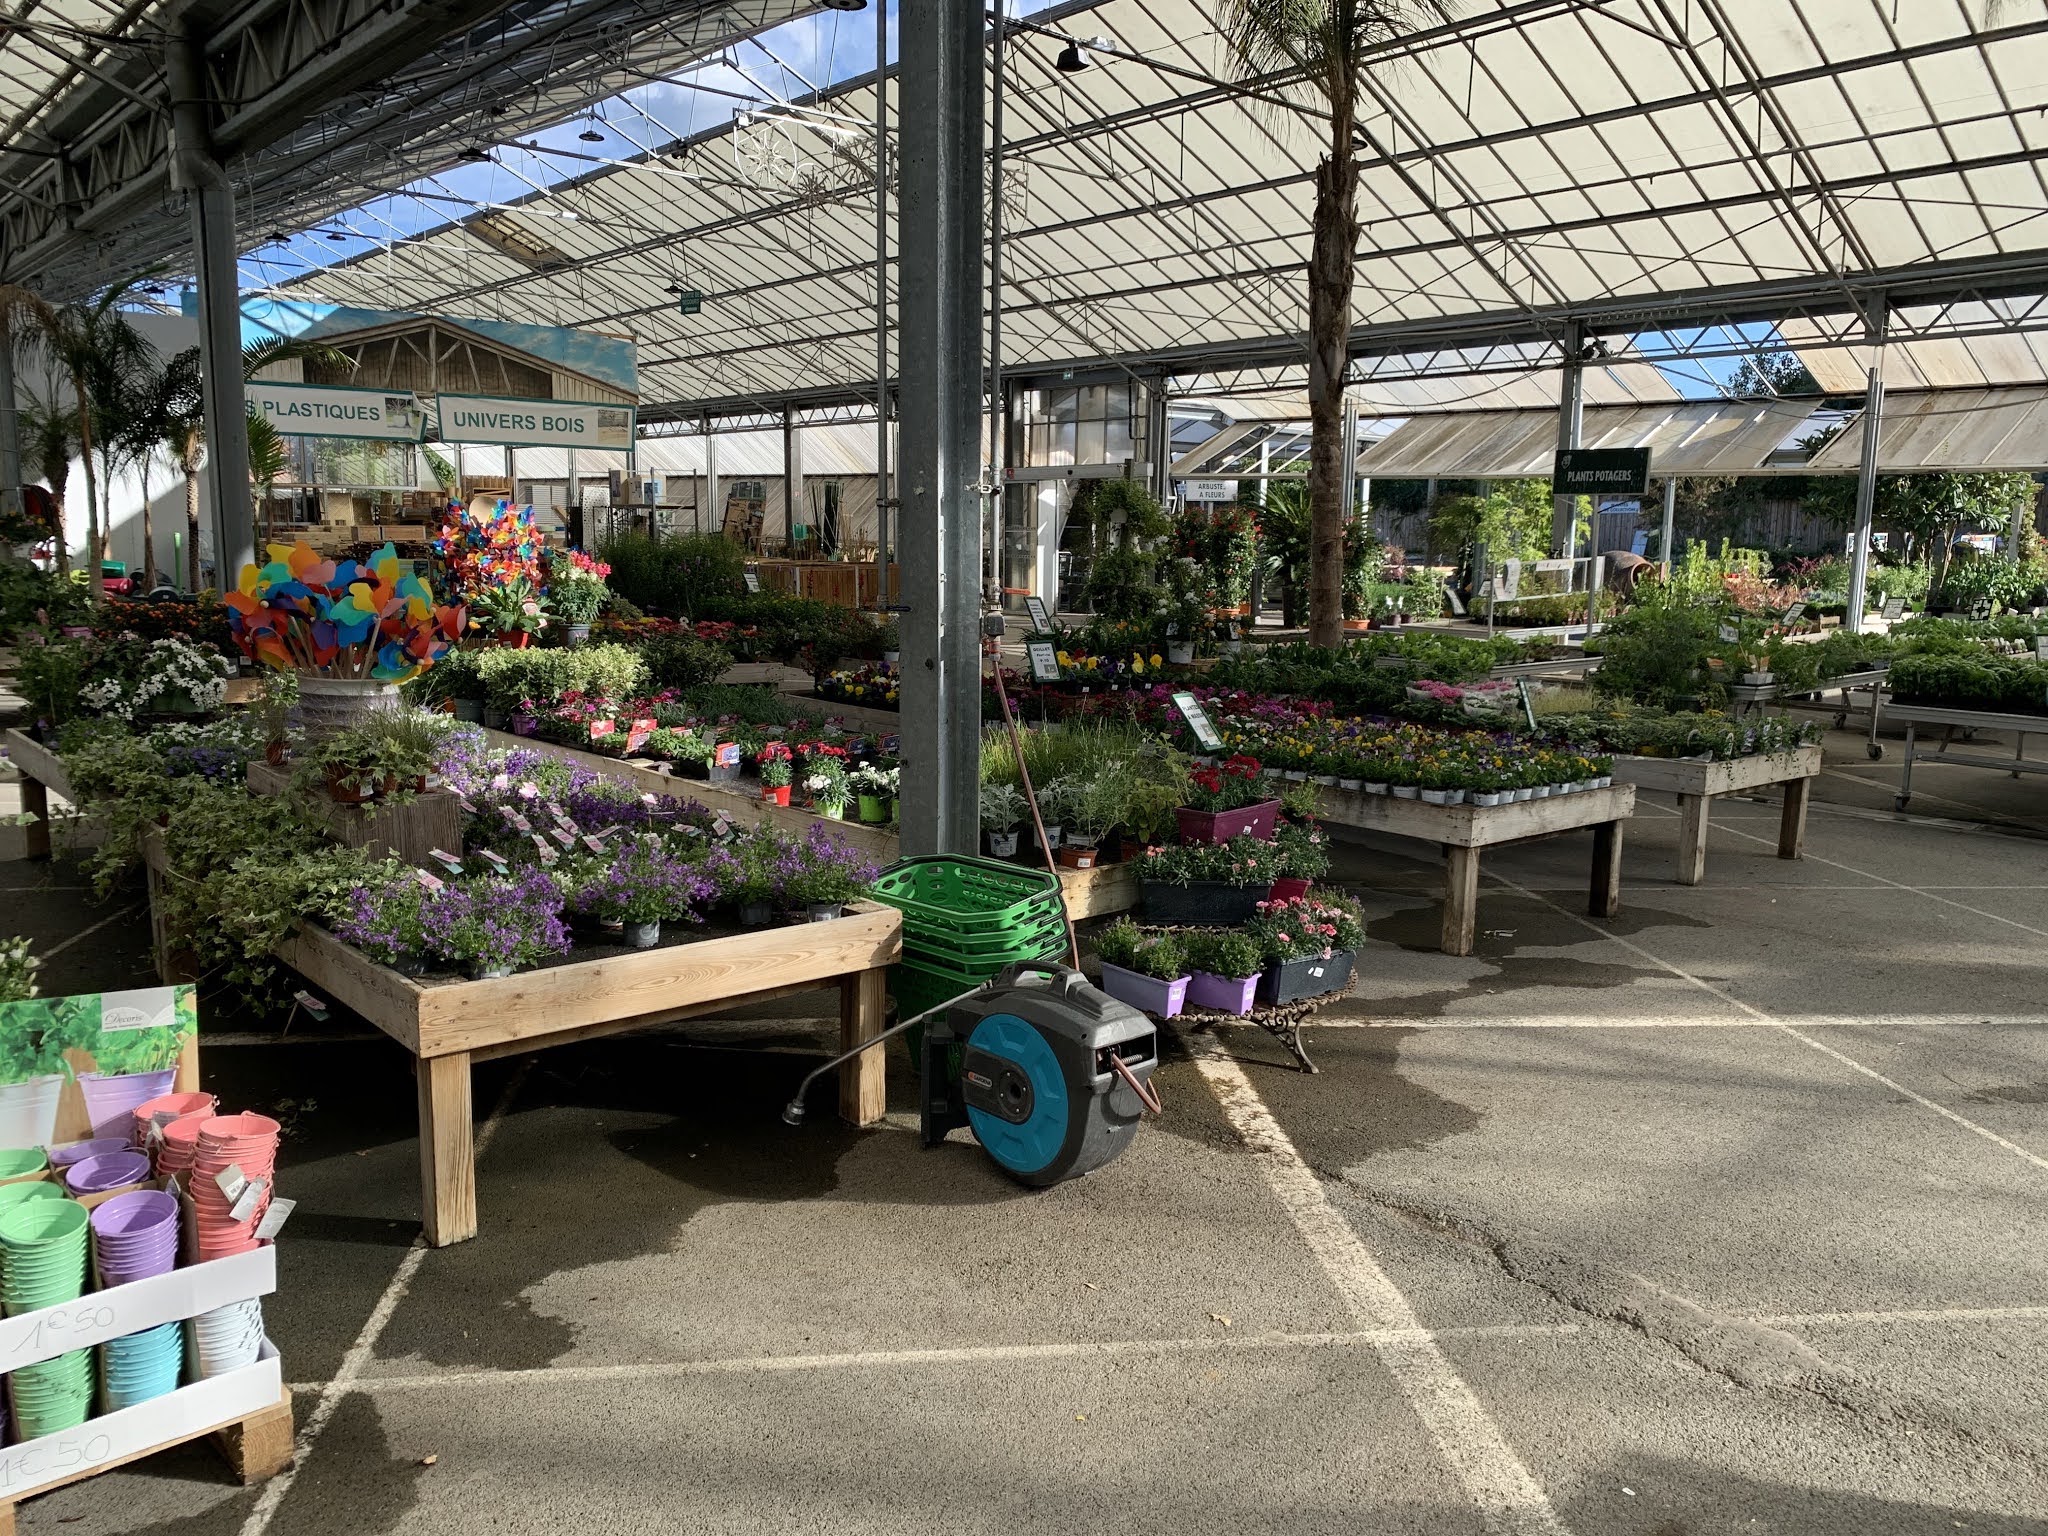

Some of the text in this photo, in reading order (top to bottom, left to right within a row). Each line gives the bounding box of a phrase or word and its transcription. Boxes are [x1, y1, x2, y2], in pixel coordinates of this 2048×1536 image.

[262, 401, 380, 422] PLASTIQUES
[453, 411, 585, 433] UNIVERS BOIS
[1567, 469, 1633, 482] PLANTS POTAGERS
[1205, 491, 1226, 499] FLEURS
